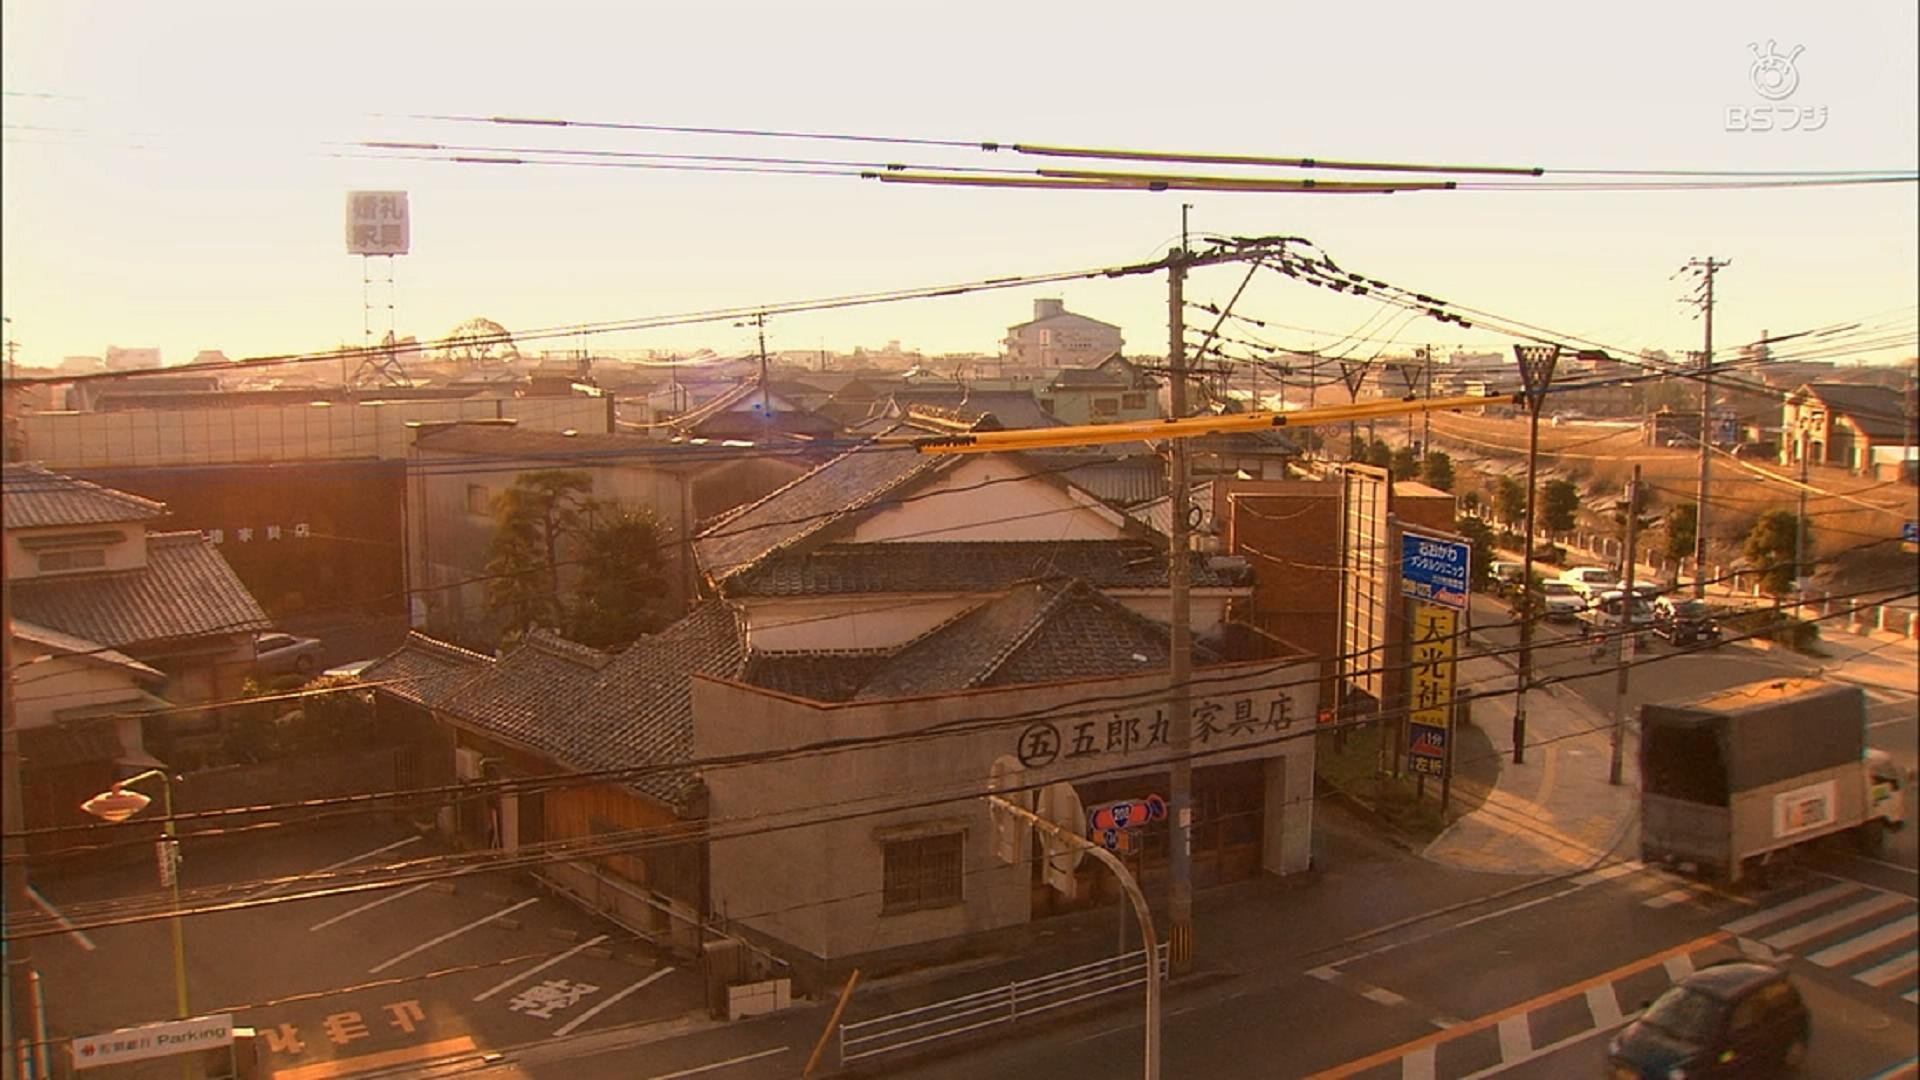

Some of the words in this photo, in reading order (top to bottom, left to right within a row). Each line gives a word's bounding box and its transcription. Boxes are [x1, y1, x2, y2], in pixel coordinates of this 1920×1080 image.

[1417, 614, 1446, 712] 天光社
[157, 1027, 226, 1046] Parking
